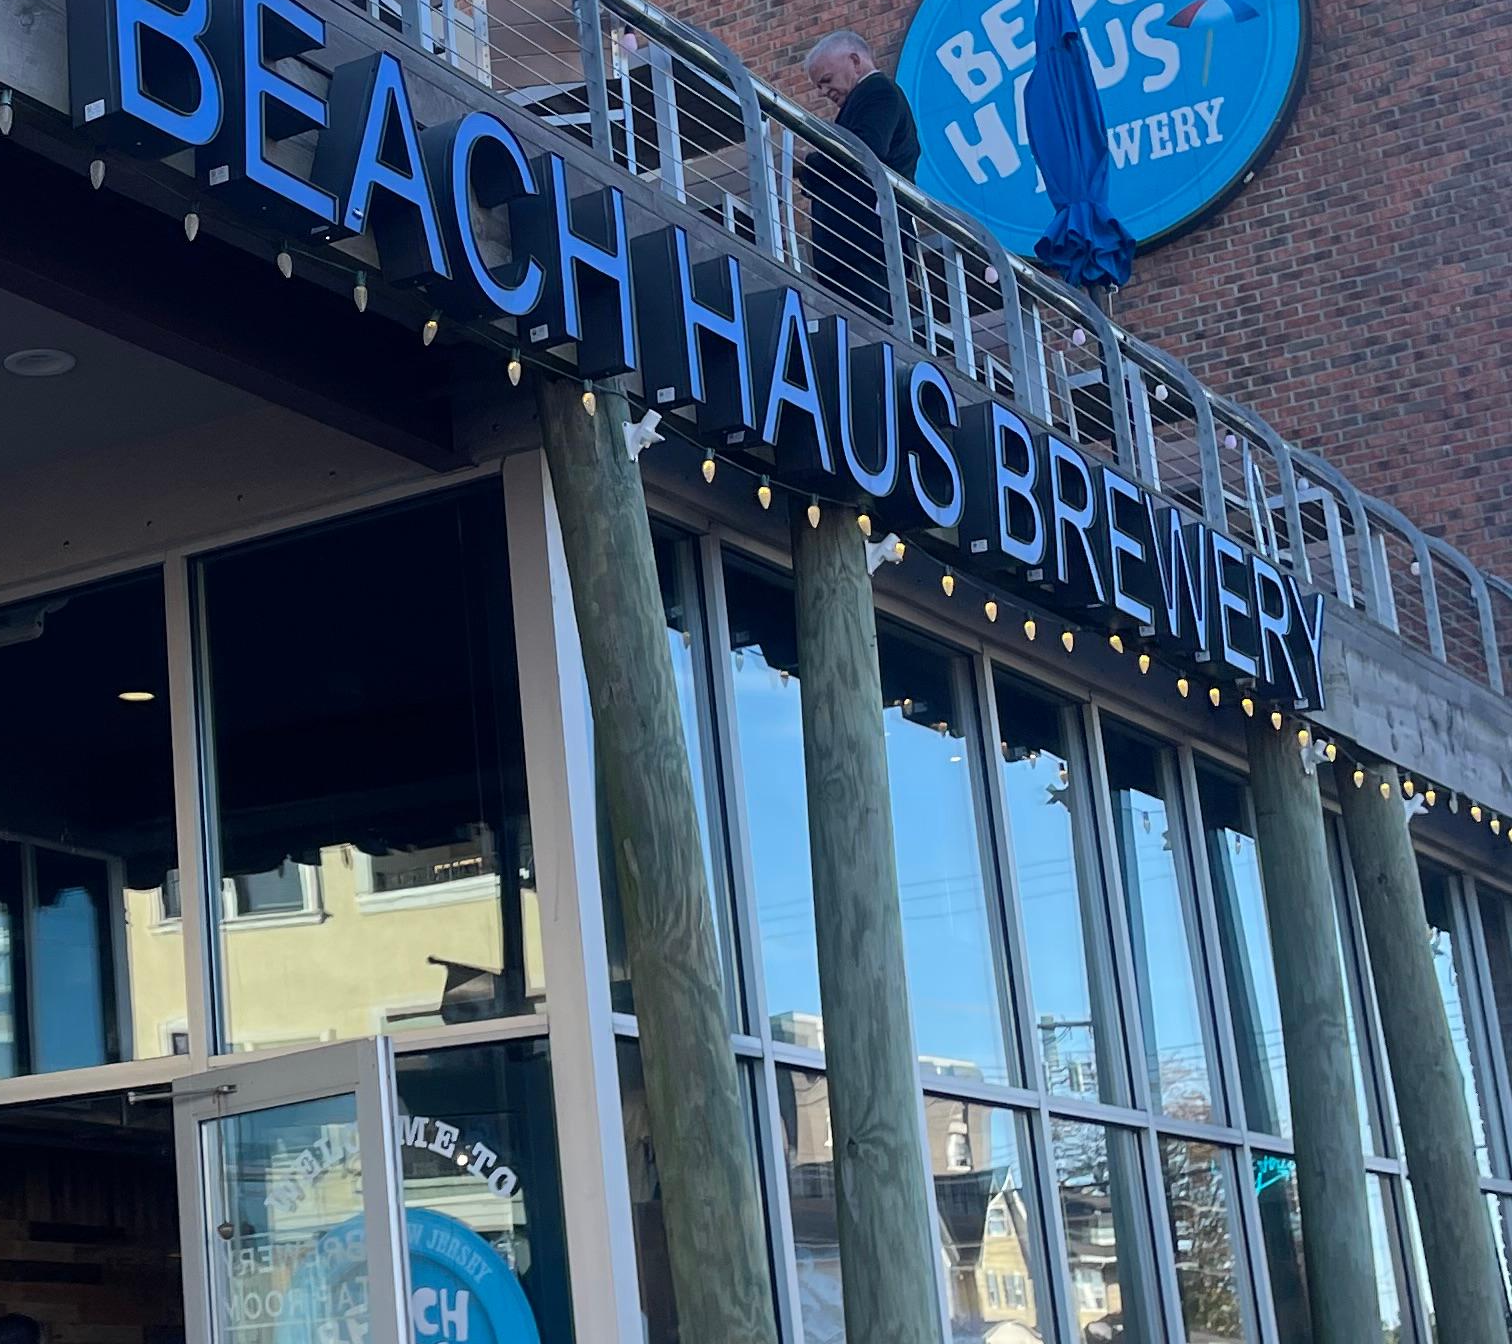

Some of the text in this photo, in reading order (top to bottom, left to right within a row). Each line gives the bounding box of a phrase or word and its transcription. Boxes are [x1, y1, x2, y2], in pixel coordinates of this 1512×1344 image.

[675, 225, 966, 529] HAUS
[992, 401, 1326, 711] BREWERY
[467, 1141, 519, 1198] TO
